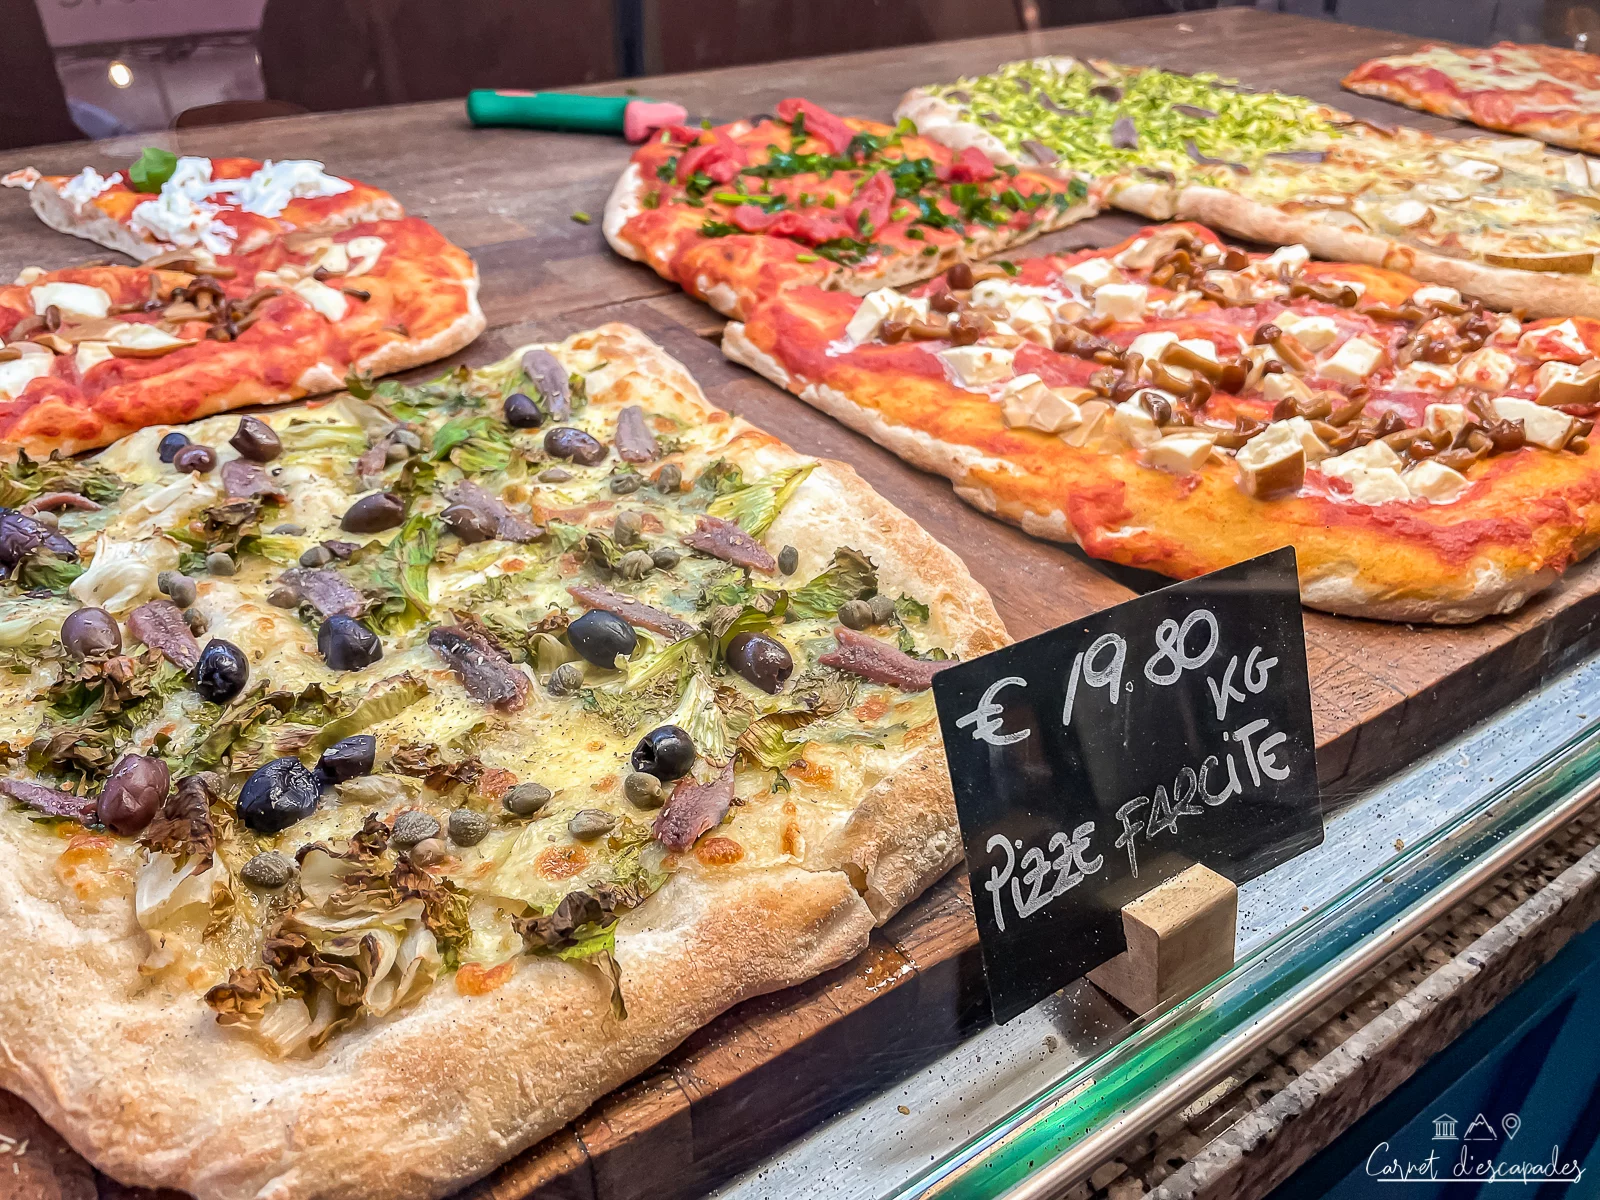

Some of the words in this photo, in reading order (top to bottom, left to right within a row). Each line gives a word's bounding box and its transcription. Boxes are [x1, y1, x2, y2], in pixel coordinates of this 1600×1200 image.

[956, 677, 1031, 746] €
[1062, 609, 1219, 725] 19.80
[1207, 646, 1279, 720] KG
